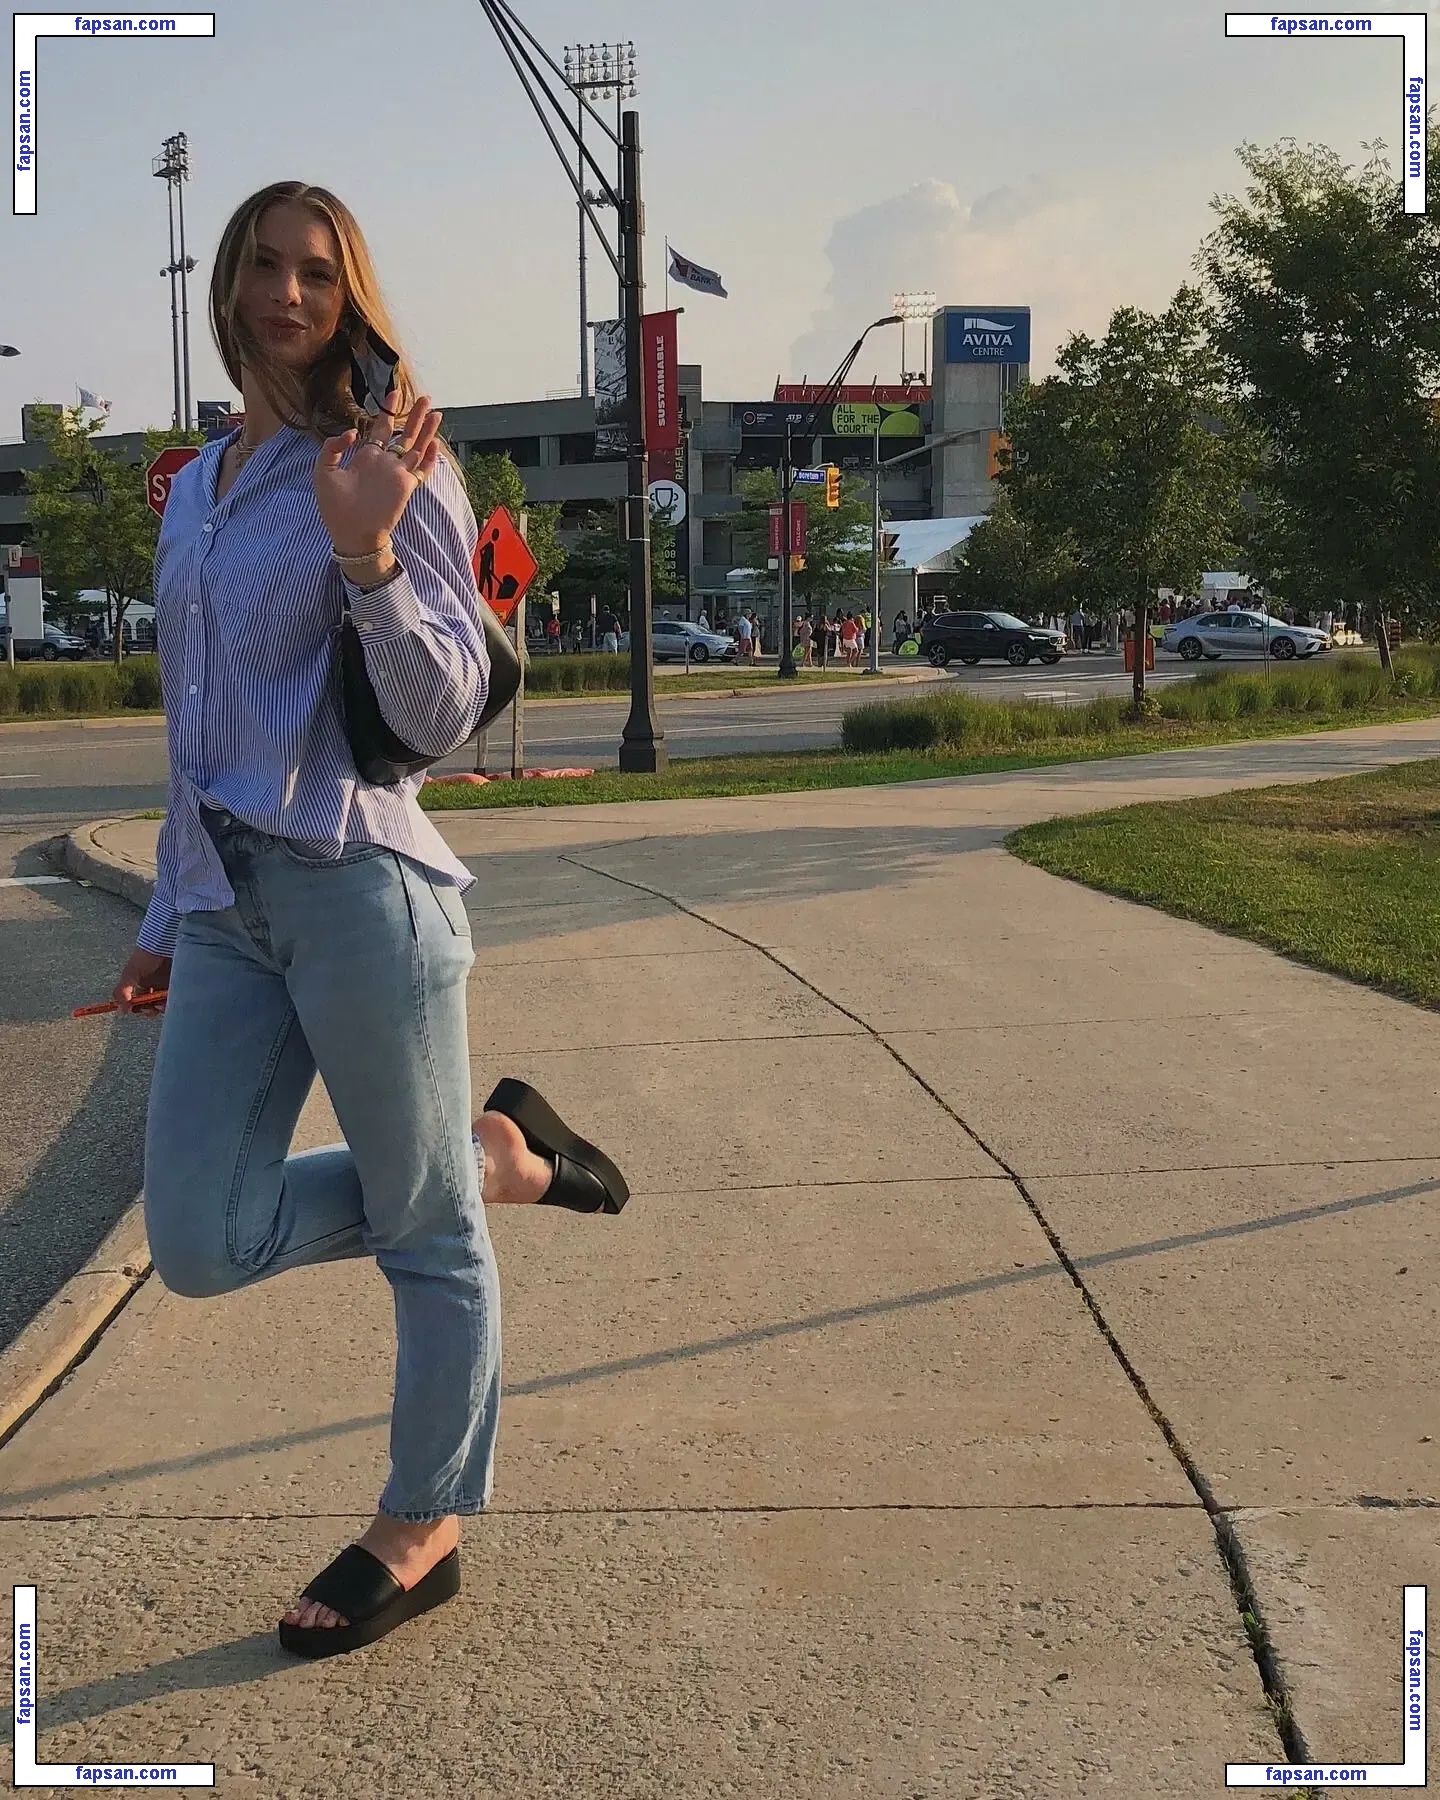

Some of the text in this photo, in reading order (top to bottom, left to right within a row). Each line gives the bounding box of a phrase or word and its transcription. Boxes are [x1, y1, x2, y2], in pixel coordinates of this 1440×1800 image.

[962, 333, 1013, 346] AVIVA
[972, 347, 1004, 356] CENTRE
[656, 335, 666, 427] SUSTAINABLE
[837, 405, 855, 413] ALL
[785, 414, 802, 422] ATP
[837, 415, 879, 423] FOR THE
[837, 425, 867, 433] COURT
[152, 473, 177, 501] ST
[664, 550, 676, 559] 08
